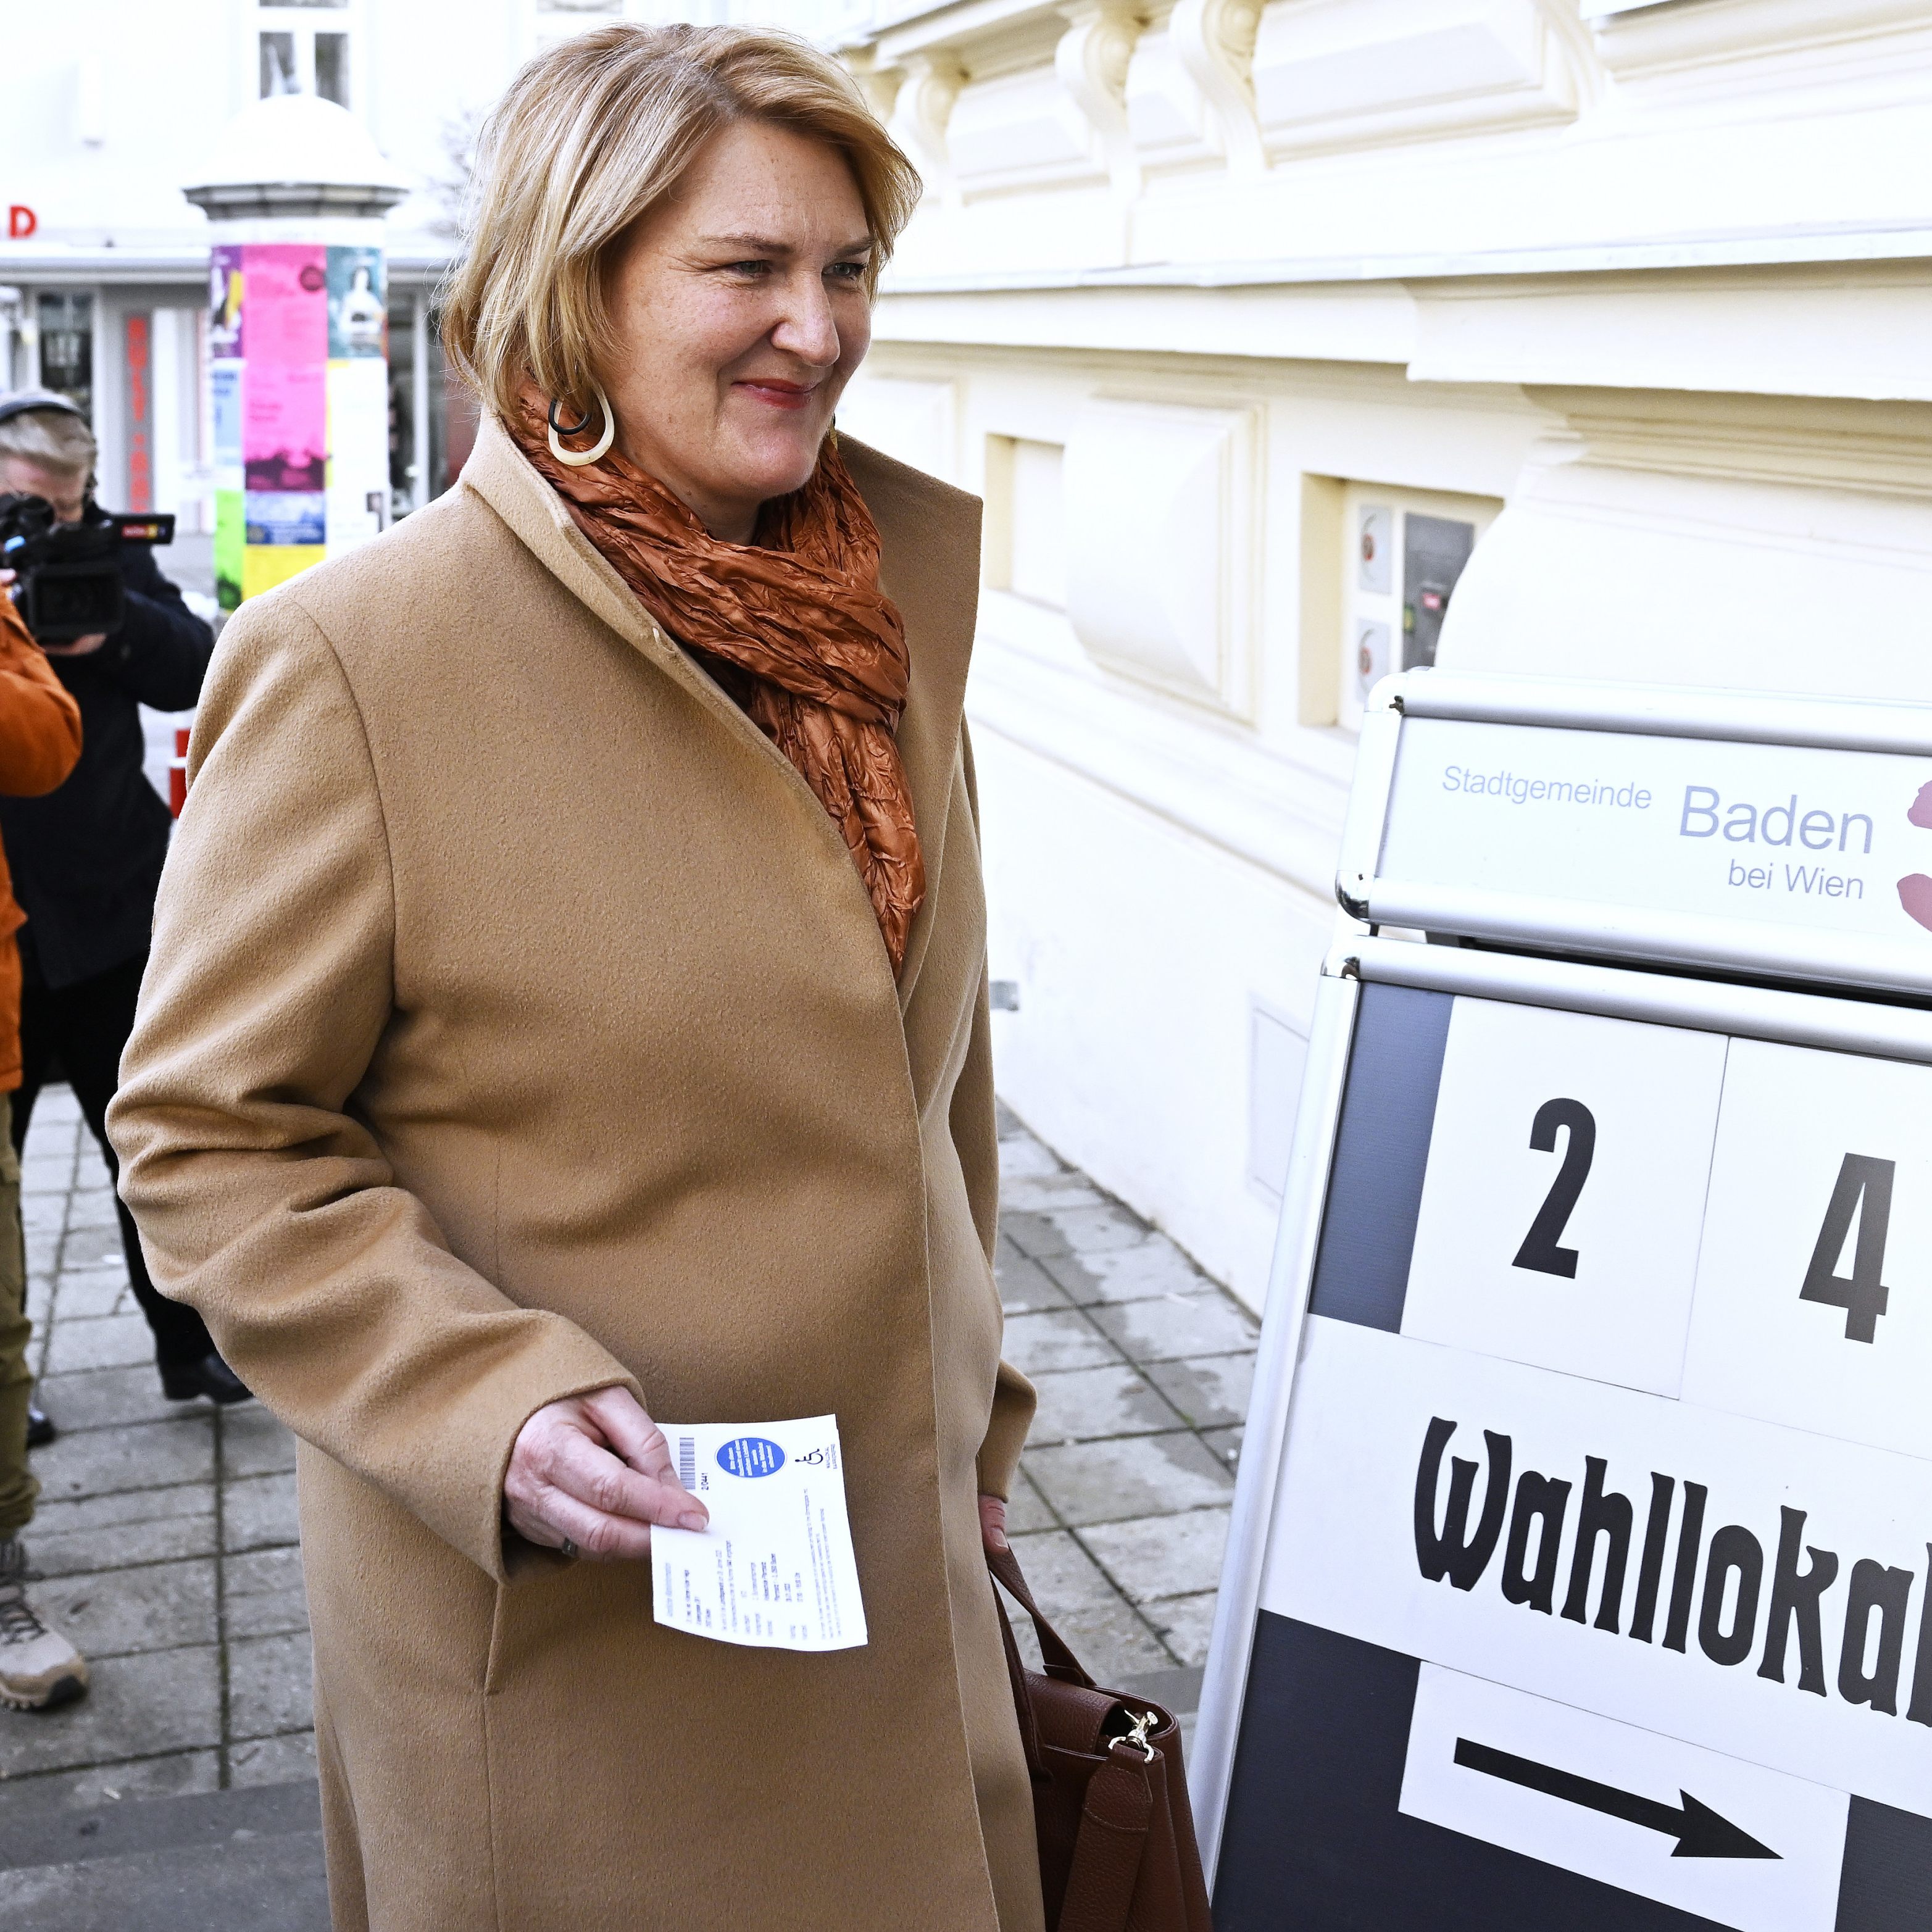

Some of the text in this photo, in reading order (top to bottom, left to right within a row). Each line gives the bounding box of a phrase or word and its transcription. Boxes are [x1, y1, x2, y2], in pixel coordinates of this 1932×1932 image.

[1442, 765, 1874, 854] Stadtgemeinde Baden
[1728, 859, 1864, 899] bei Wien
[1512, 1097, 1896, 1344] 2 4
[1414, 1416, 1932, 1728] Wahllokal
